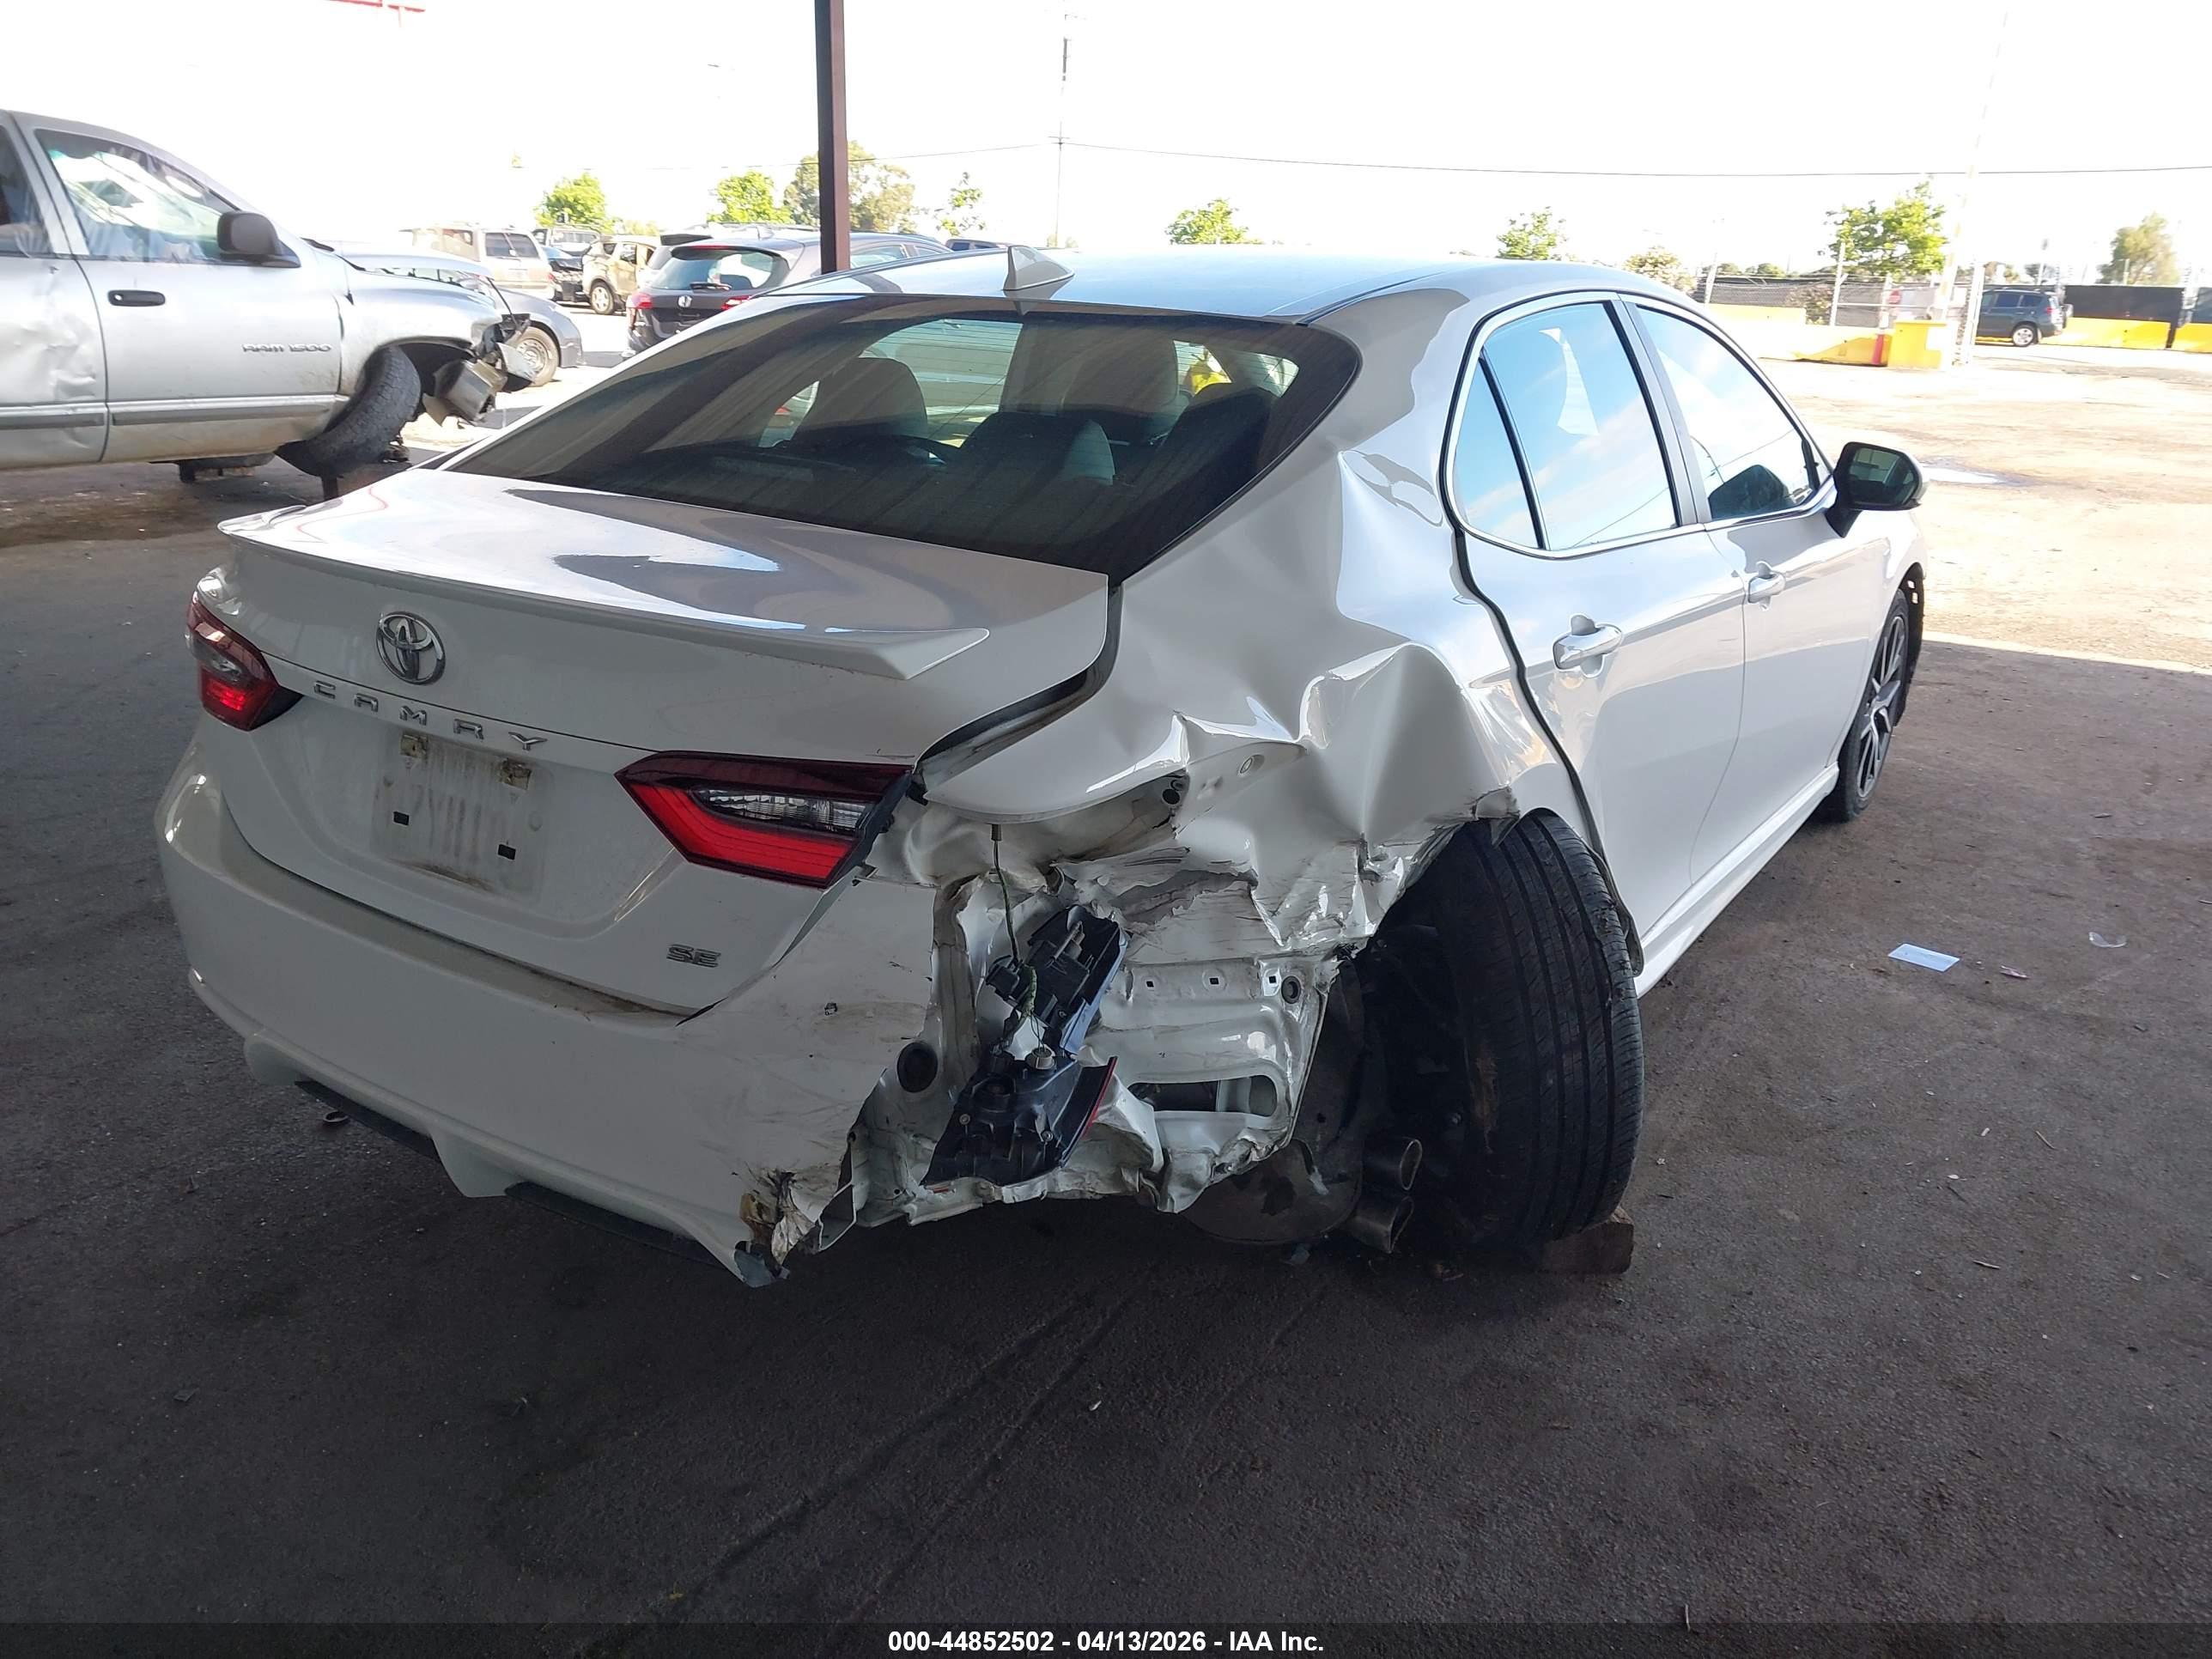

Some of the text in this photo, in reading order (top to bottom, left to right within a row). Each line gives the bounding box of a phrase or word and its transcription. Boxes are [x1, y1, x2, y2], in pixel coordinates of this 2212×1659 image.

[241, 343, 332, 353] RAM 1500
[313, 680, 548, 751] CAMRY
[666, 944, 721, 968] SE
